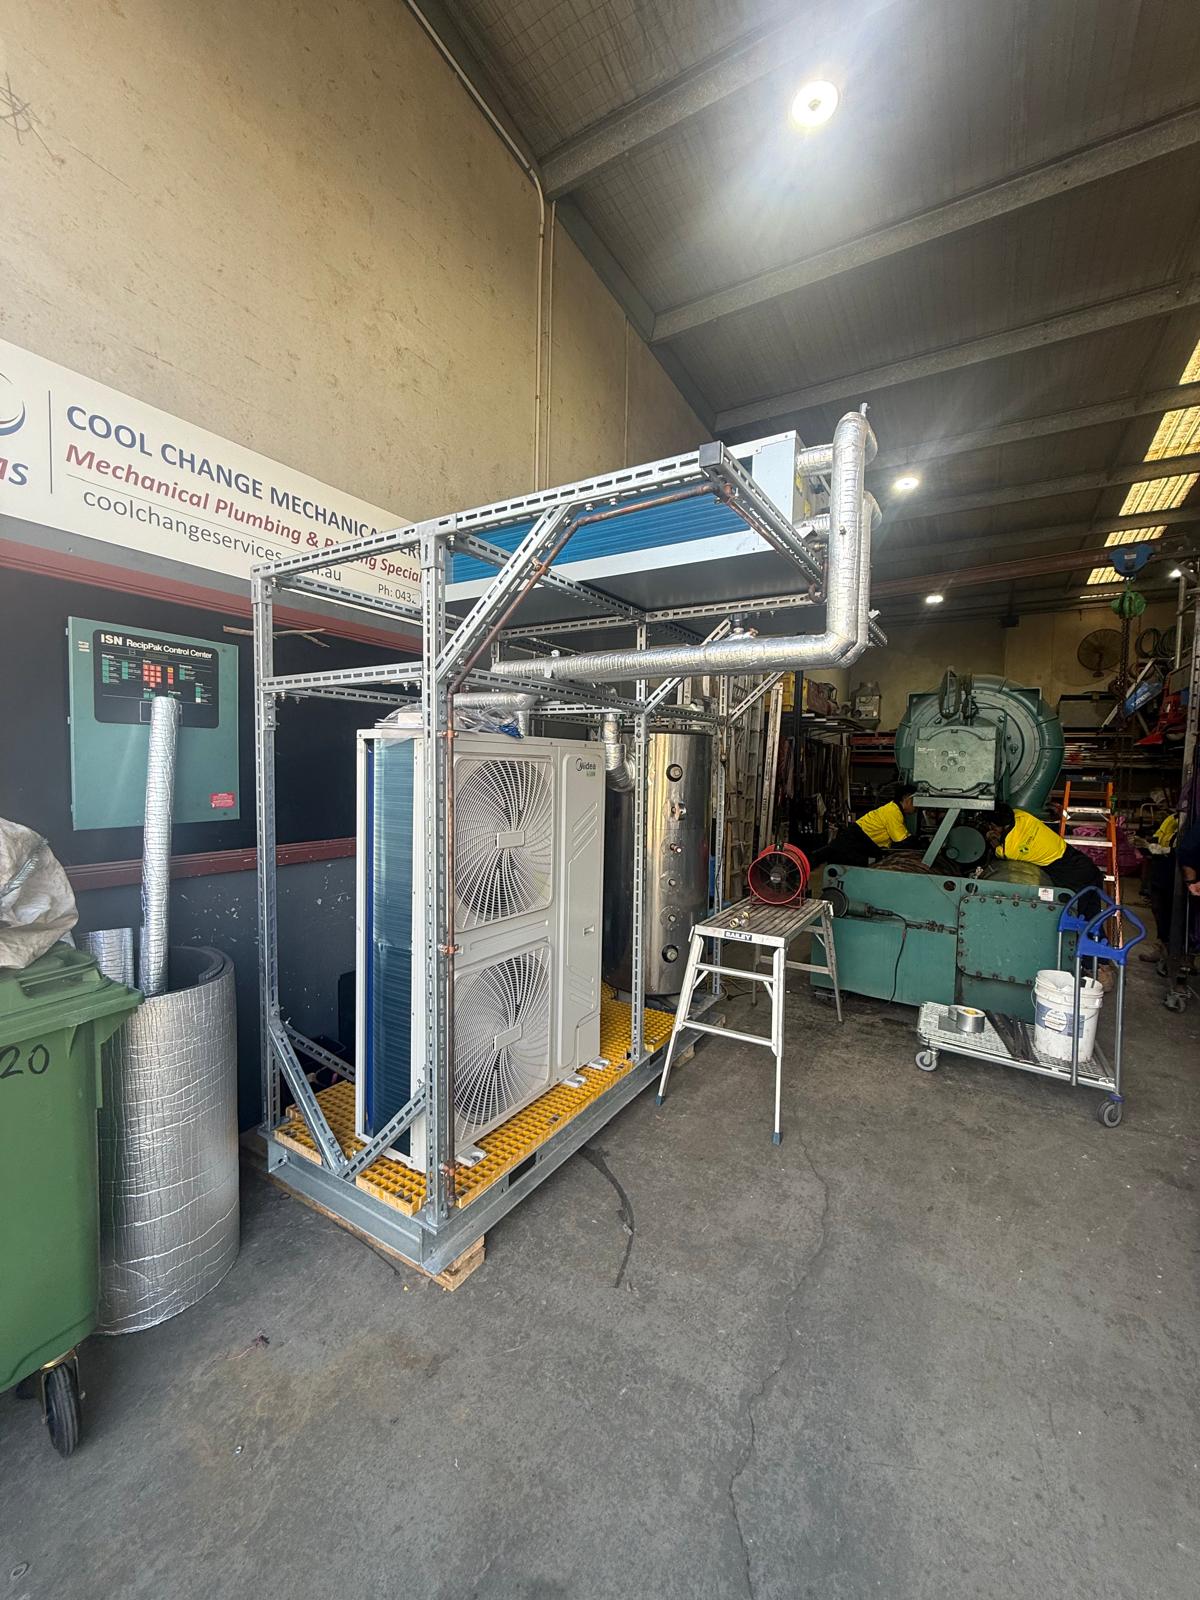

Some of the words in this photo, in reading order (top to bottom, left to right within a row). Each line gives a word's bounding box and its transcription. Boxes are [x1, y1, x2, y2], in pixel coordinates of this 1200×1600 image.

[66, 405, 153, 457] COOL
[160, 443, 263, 500] CHANGE
[65, 444, 210, 510] Mechanical
[214, 498, 302, 545] Plumbing
[305, 532, 319, 549] &
[378, 583, 393, 598] Ph:
[100, 633, 123, 646] ISN
[126, 638, 163, 652] RecipPak
[163, 645, 190, 656] Control
[190, 649, 213, 659] Center
